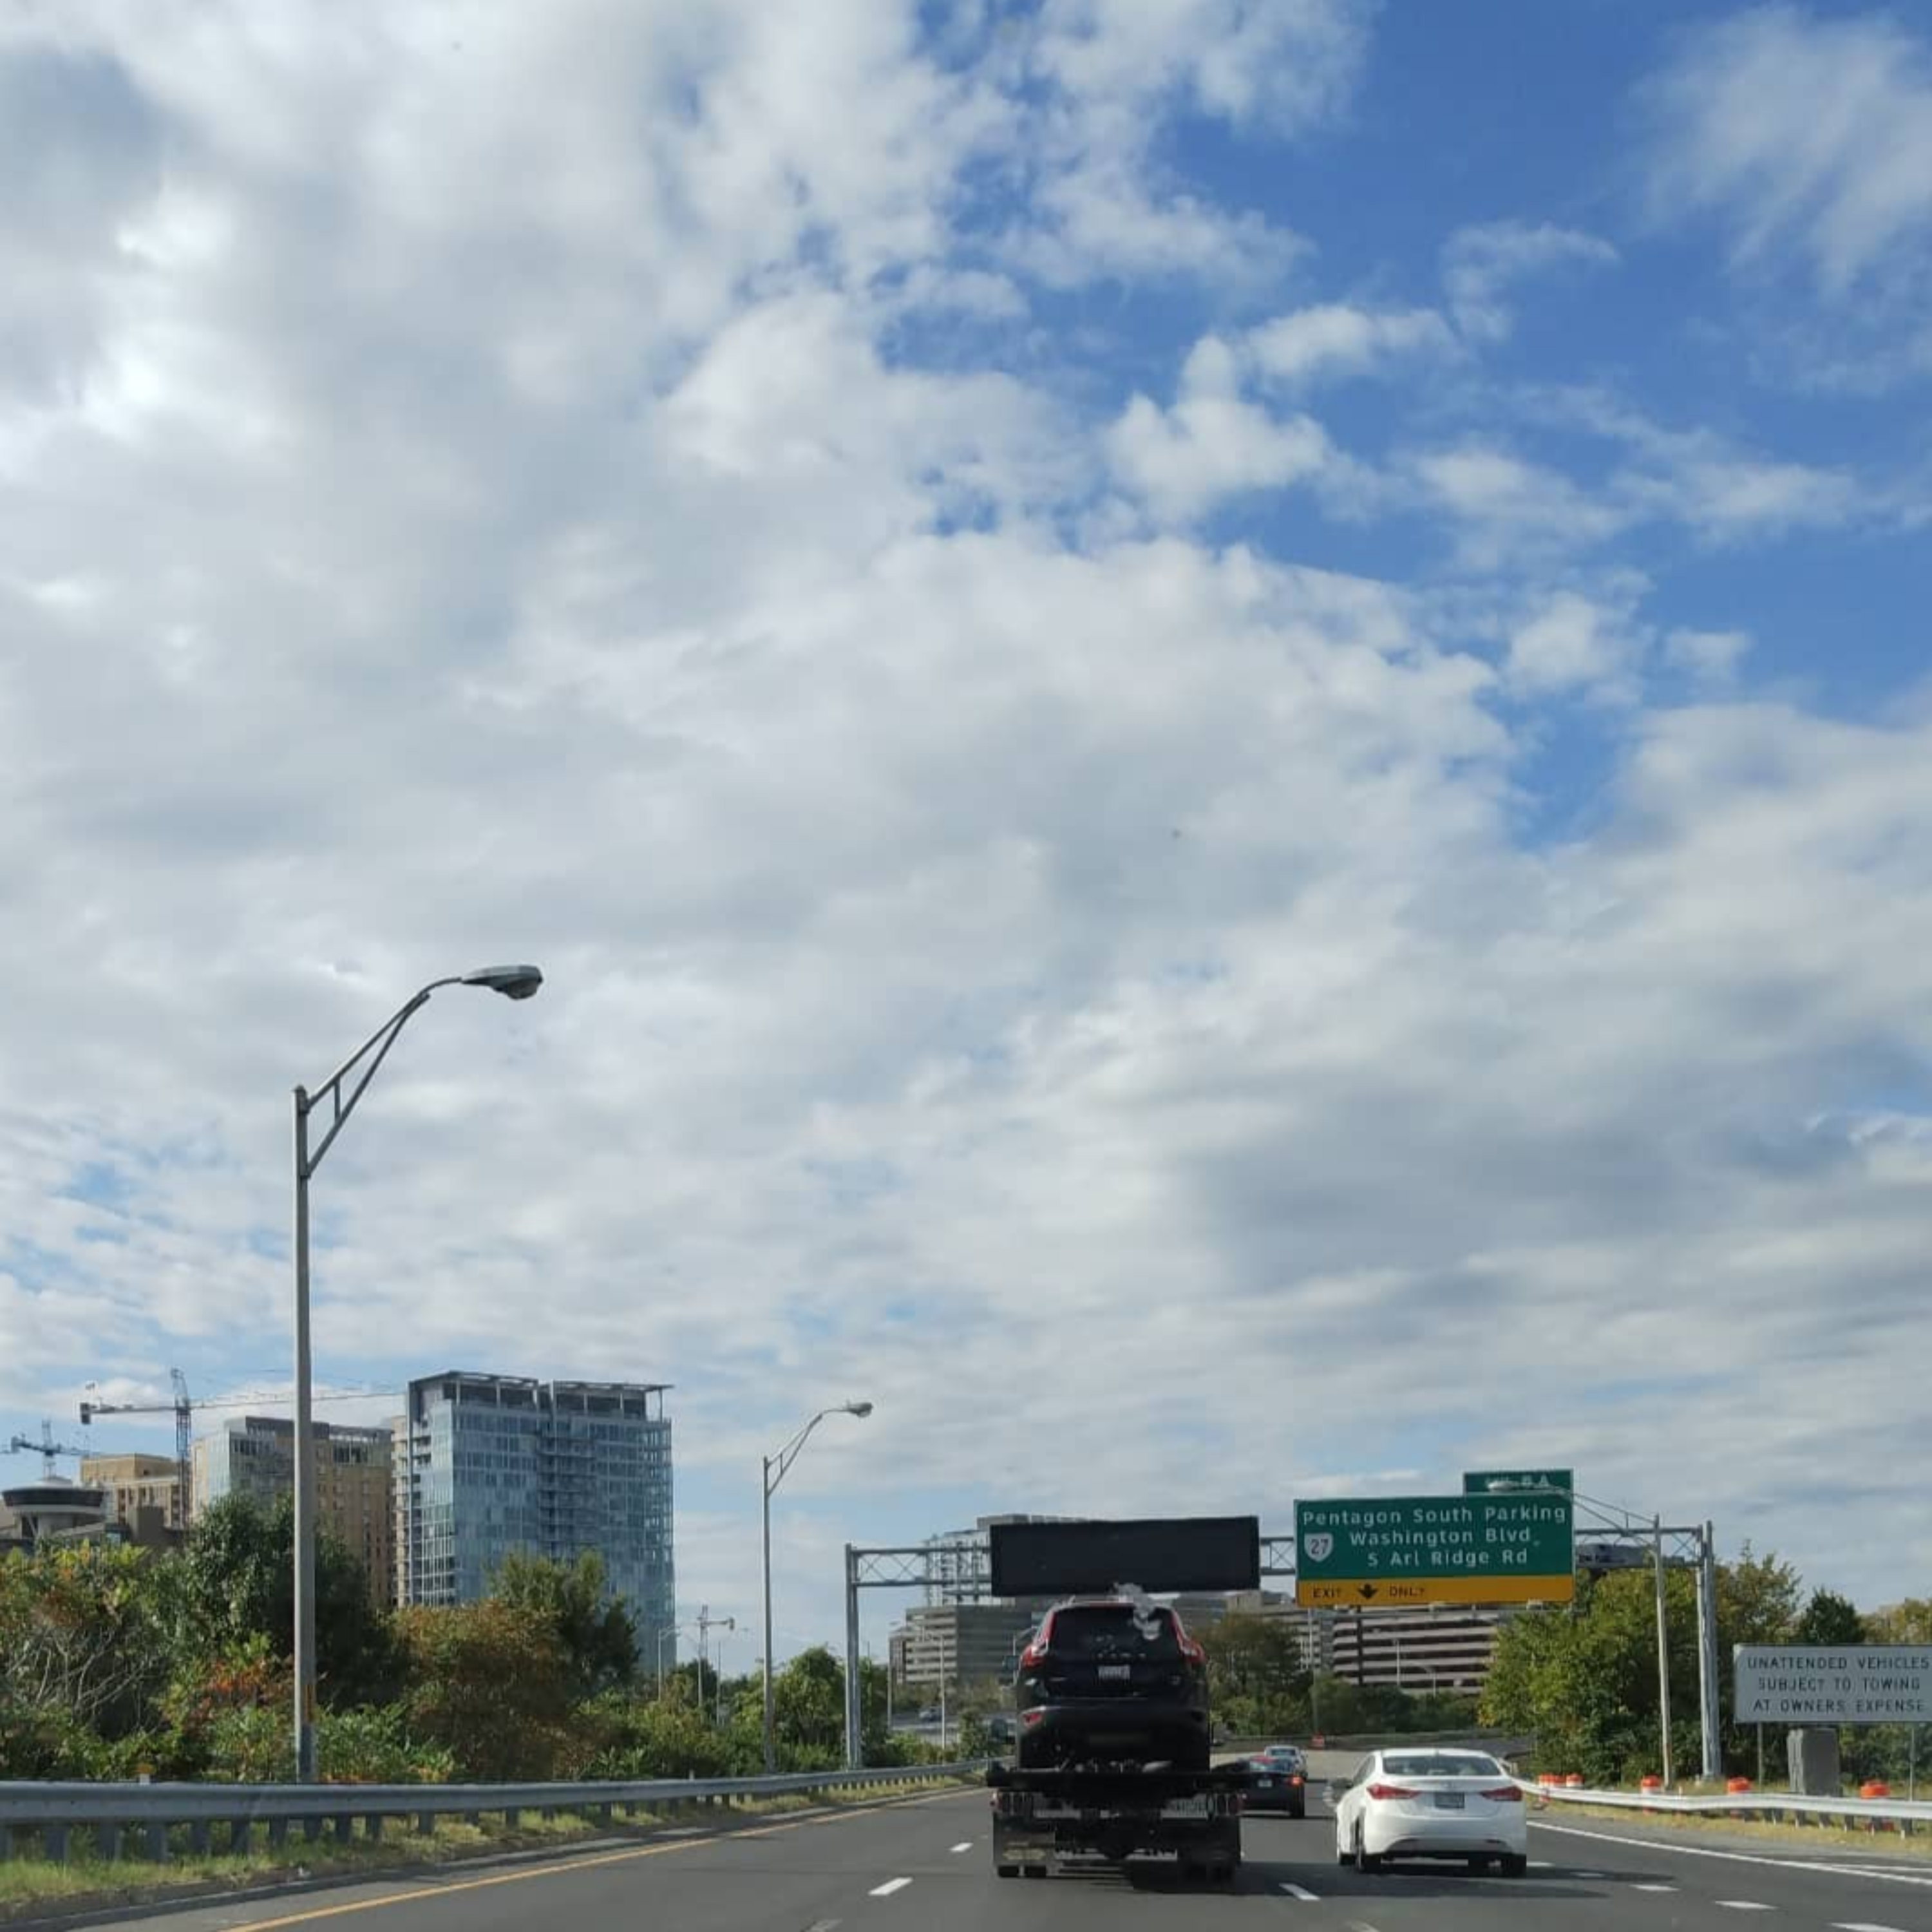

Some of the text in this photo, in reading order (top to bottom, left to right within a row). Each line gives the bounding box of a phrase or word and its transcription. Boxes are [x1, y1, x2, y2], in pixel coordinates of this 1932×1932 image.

[1303, 1503, 1566, 1528] Pentagon South Parking
[1310, 1538, 1329, 1555] 27
[1350, 1529, 1473, 1547] Washington
[1368, 1548, 1527, 1567] S Arl Ridge Rd
[1747, 1656, 1929, 1669] UNATTENDED VEHICLES
[1759, 1676, 1920, 1691] SUBJECT TO TOWING
[1754, 1698, 1924, 1713] AT OWNERS EXPENSE
